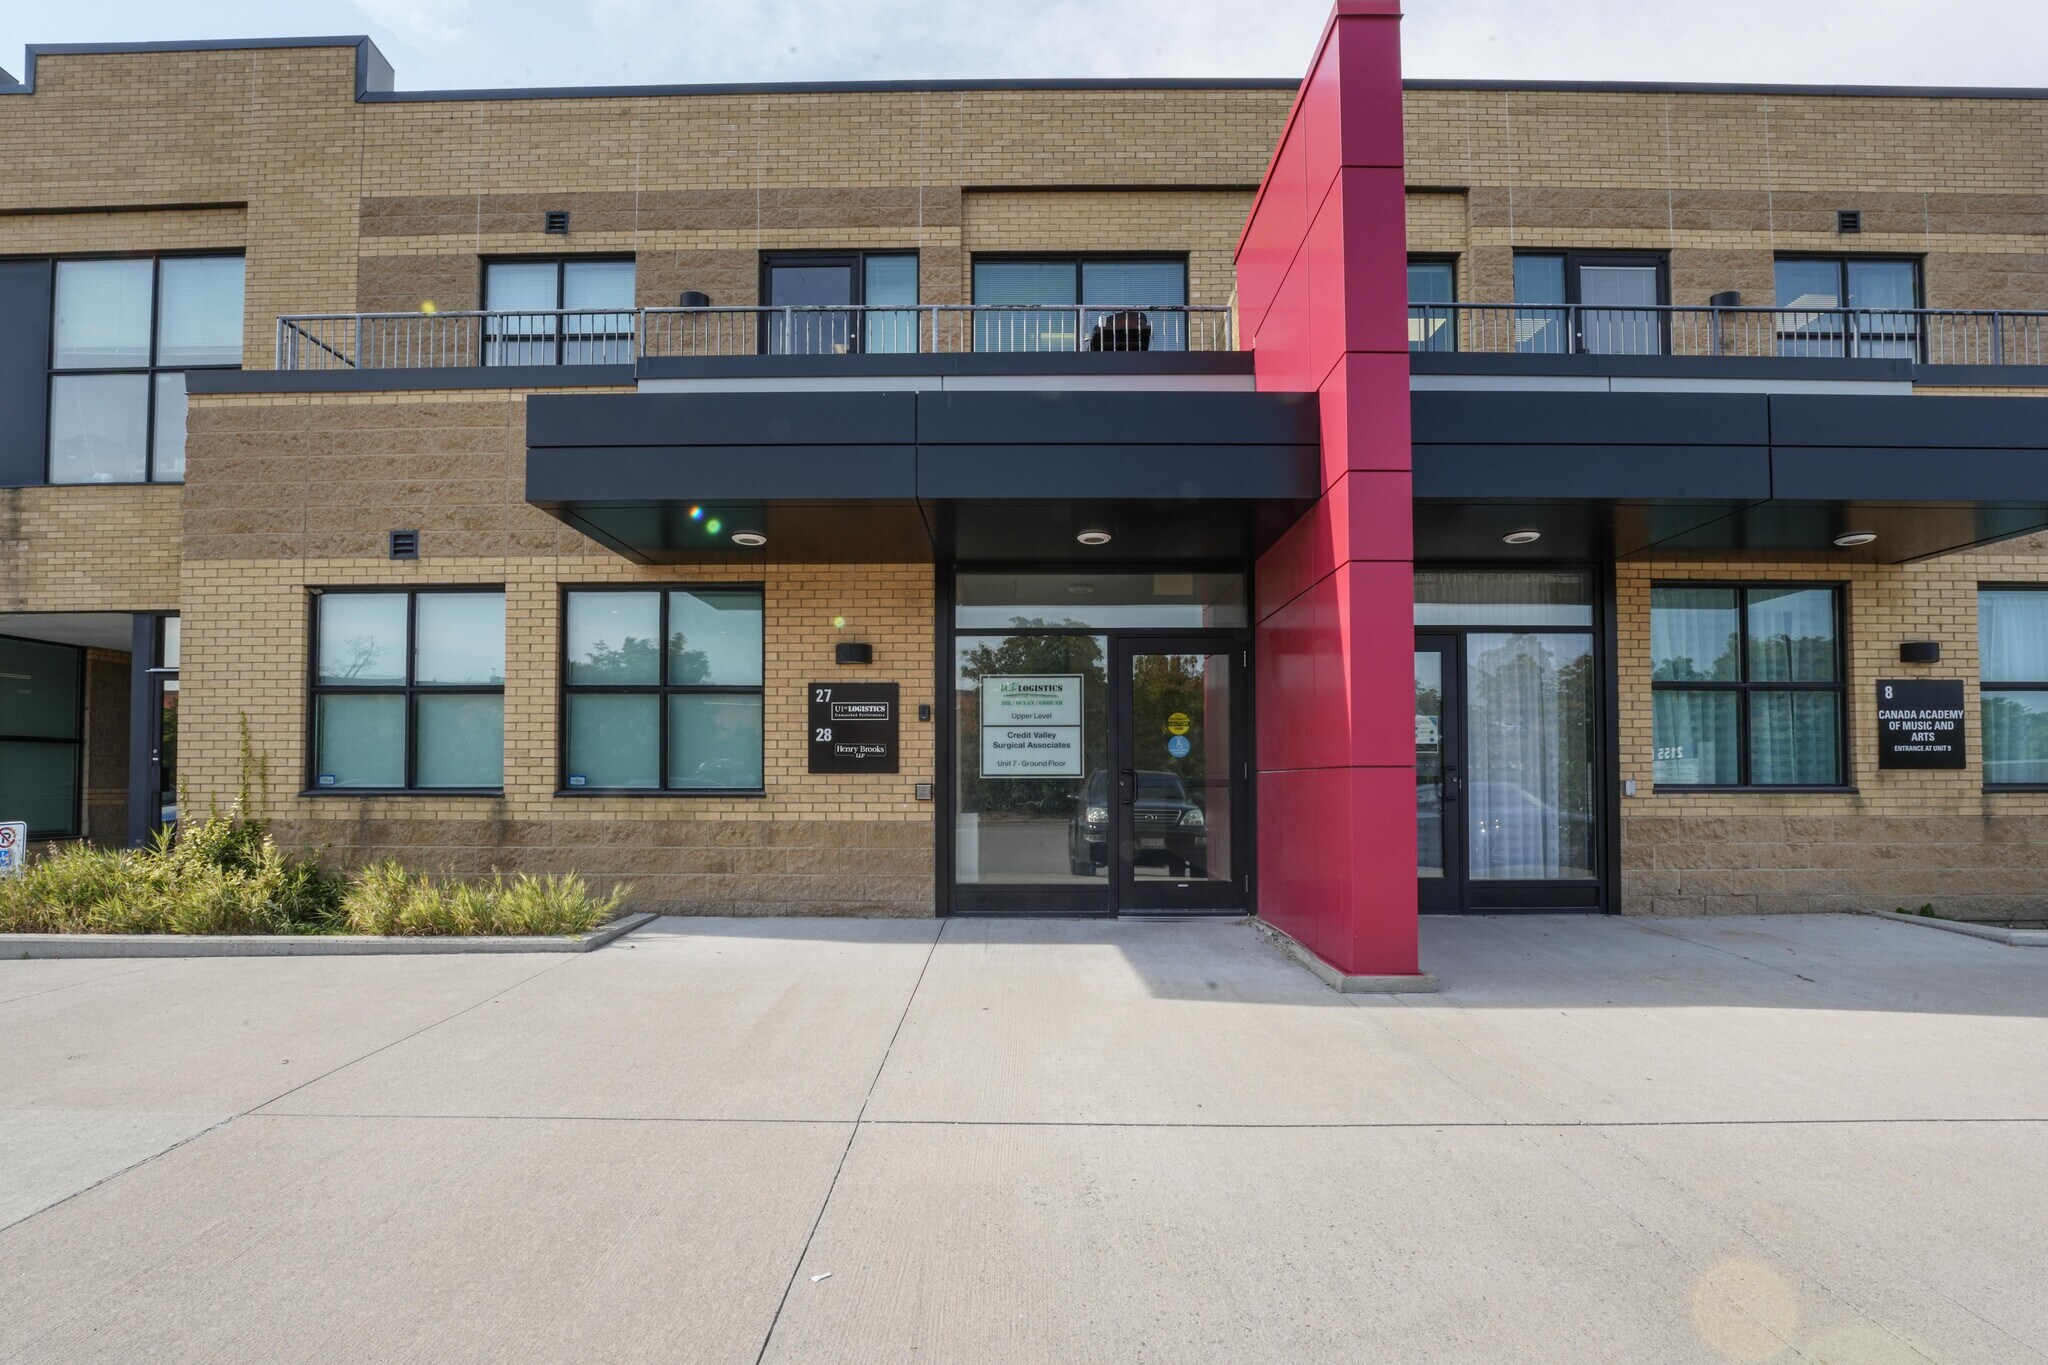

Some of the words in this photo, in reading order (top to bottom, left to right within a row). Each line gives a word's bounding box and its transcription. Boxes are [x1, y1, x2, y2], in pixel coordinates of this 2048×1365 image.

[1018, 684, 1063, 692] LOGISTICS
[1884, 685, 1893, 699] 8
[816, 689, 831, 702] 27
[1011, 712, 1032, 720] Upper
[1878, 710, 1917, 720] CANADA
[1919, 710, 1964, 720] ACADEMY
[1888, 721, 1901, 731] OF
[1902, 721, 1933, 731] MUSIC
[1934, 721, 1954, 731] AND
[816, 728, 832, 741] 28
[1007, 731, 1031, 739] Credit
[1033, 731, 1057, 740] Valley
[1911, 732, 1935, 742] ARTS
[836, 745, 858, 753] Henry
[992, 741, 1025, 750] Surgical
[1027, 741, 1071, 749] Associates
